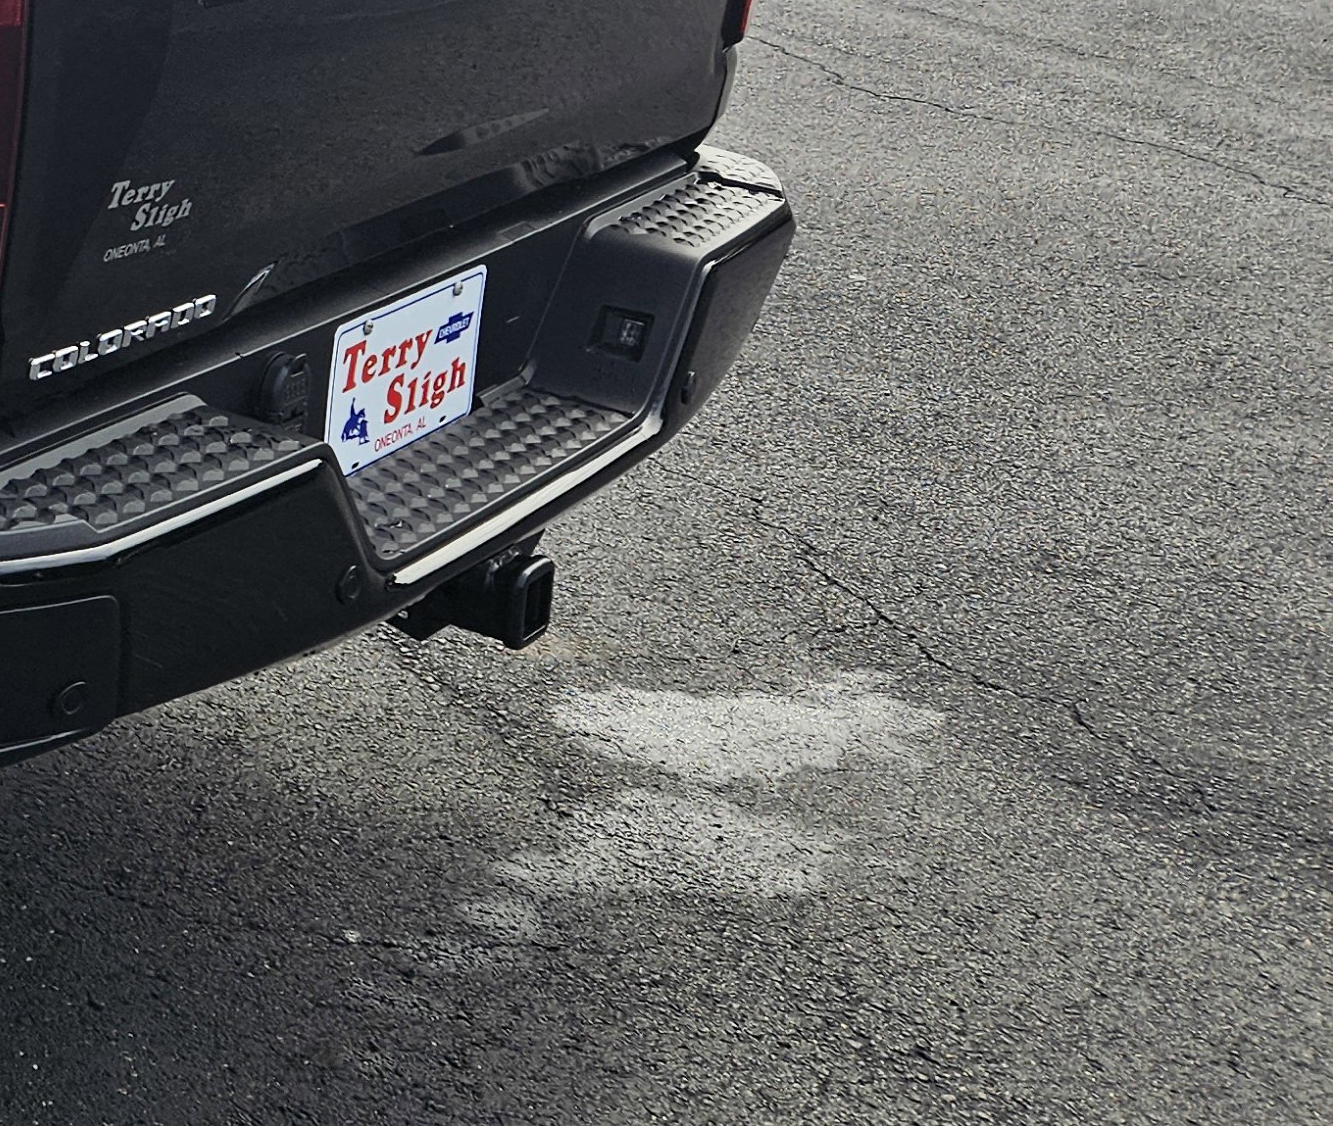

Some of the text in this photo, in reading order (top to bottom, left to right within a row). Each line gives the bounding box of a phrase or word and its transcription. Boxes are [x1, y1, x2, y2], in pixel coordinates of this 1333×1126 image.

[107, 179, 176, 210] Terry
[130, 198, 193, 232] Sligh
[29, 294, 217, 381] COLORADO
[342, 329, 433, 393] Terry
[384, 357, 466, 424] Sligh
